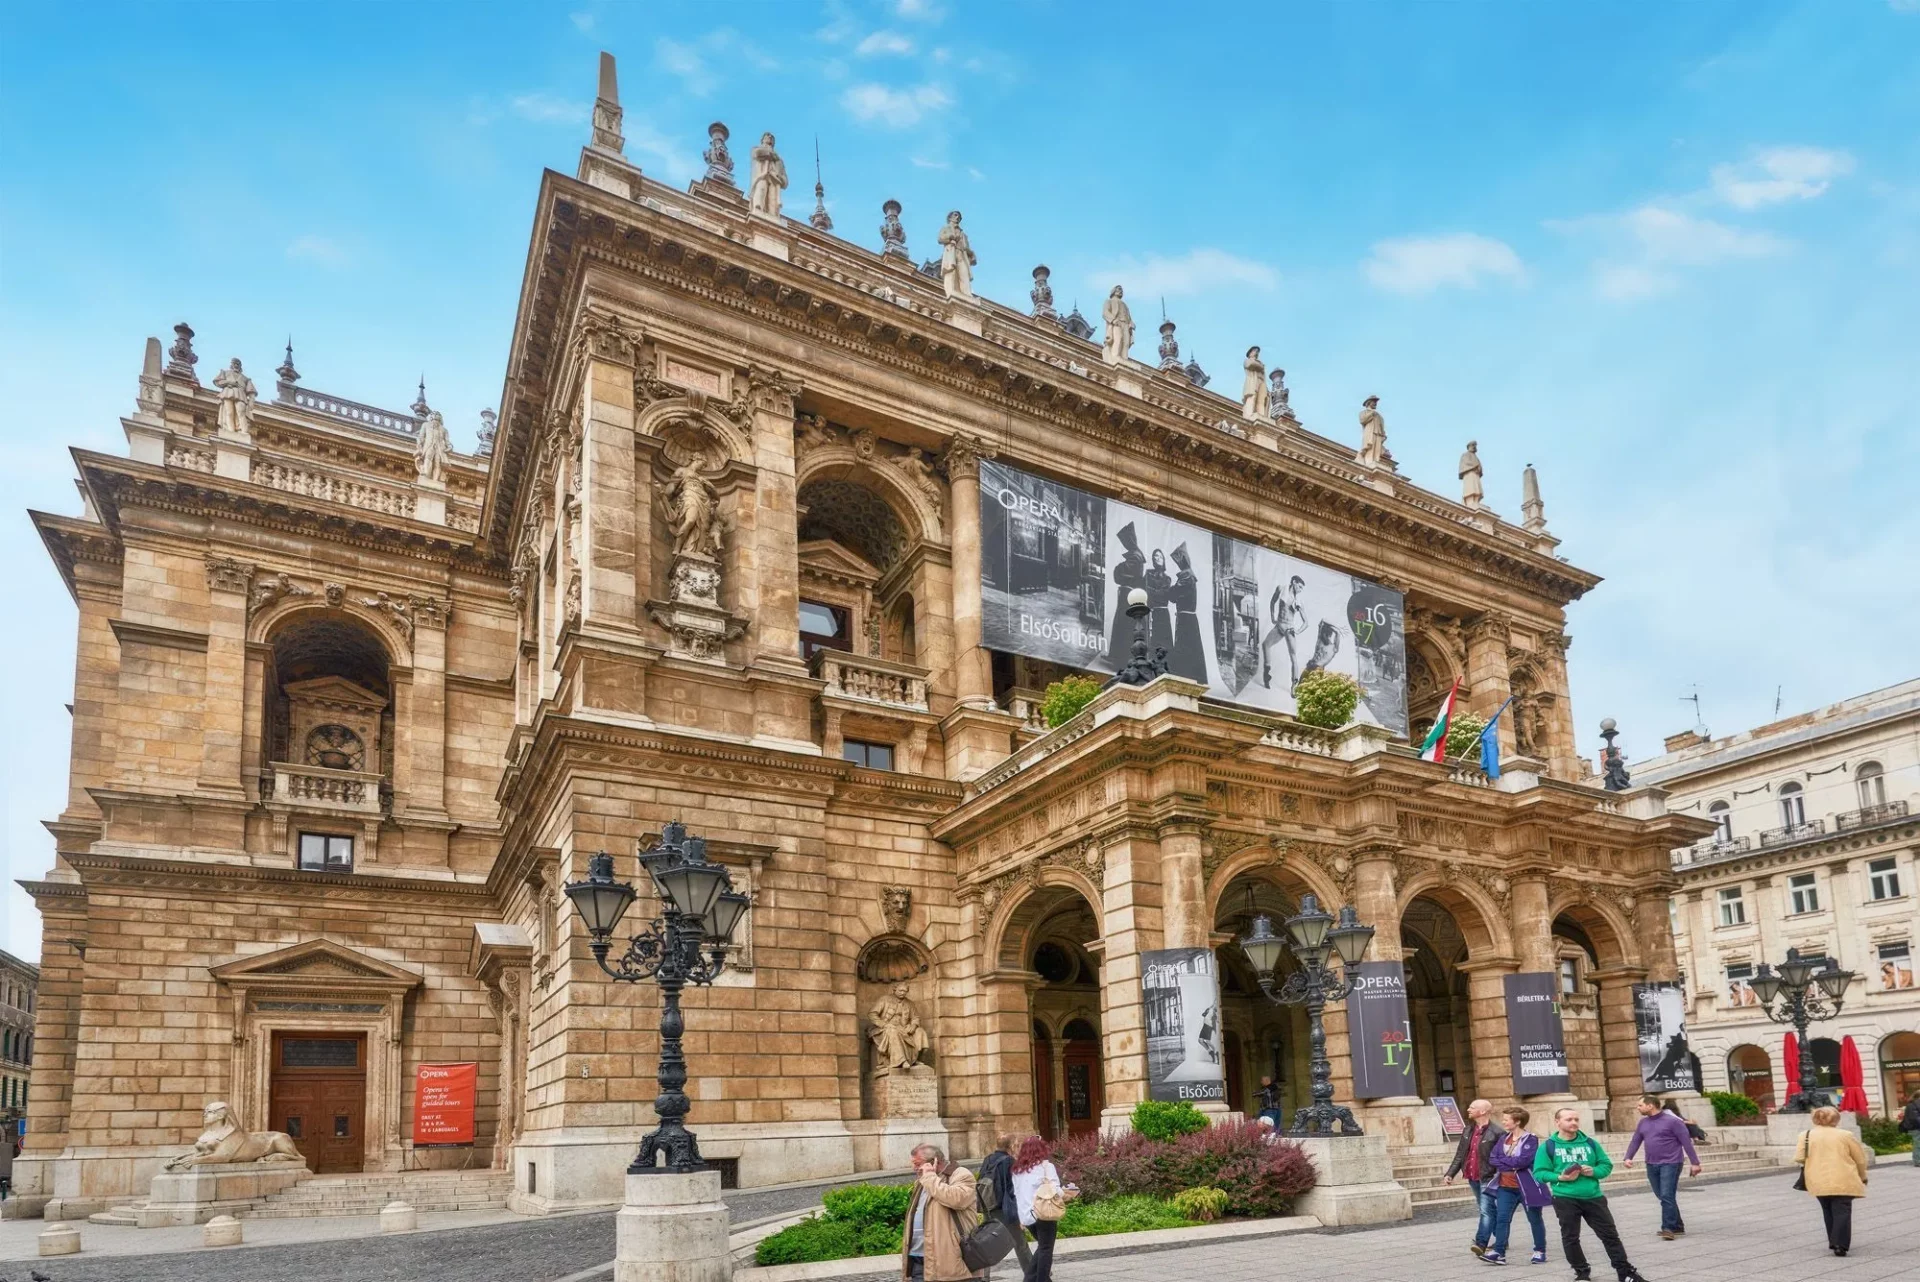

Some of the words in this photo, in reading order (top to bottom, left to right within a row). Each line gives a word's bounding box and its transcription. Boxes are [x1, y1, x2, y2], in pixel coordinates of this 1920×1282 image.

[998, 489, 1063, 521] OPERA
[1021, 614, 1108, 652] ElsőSorban
[1353, 976, 1402, 990] OPERA
[1381, 1043, 1412, 1075] 17
[1521, 1051, 1554, 1059] MÁRCIUS
[420, 1070, 448, 1079] OPERA
[1523, 1067, 1550, 1076] ÁPRILIS
